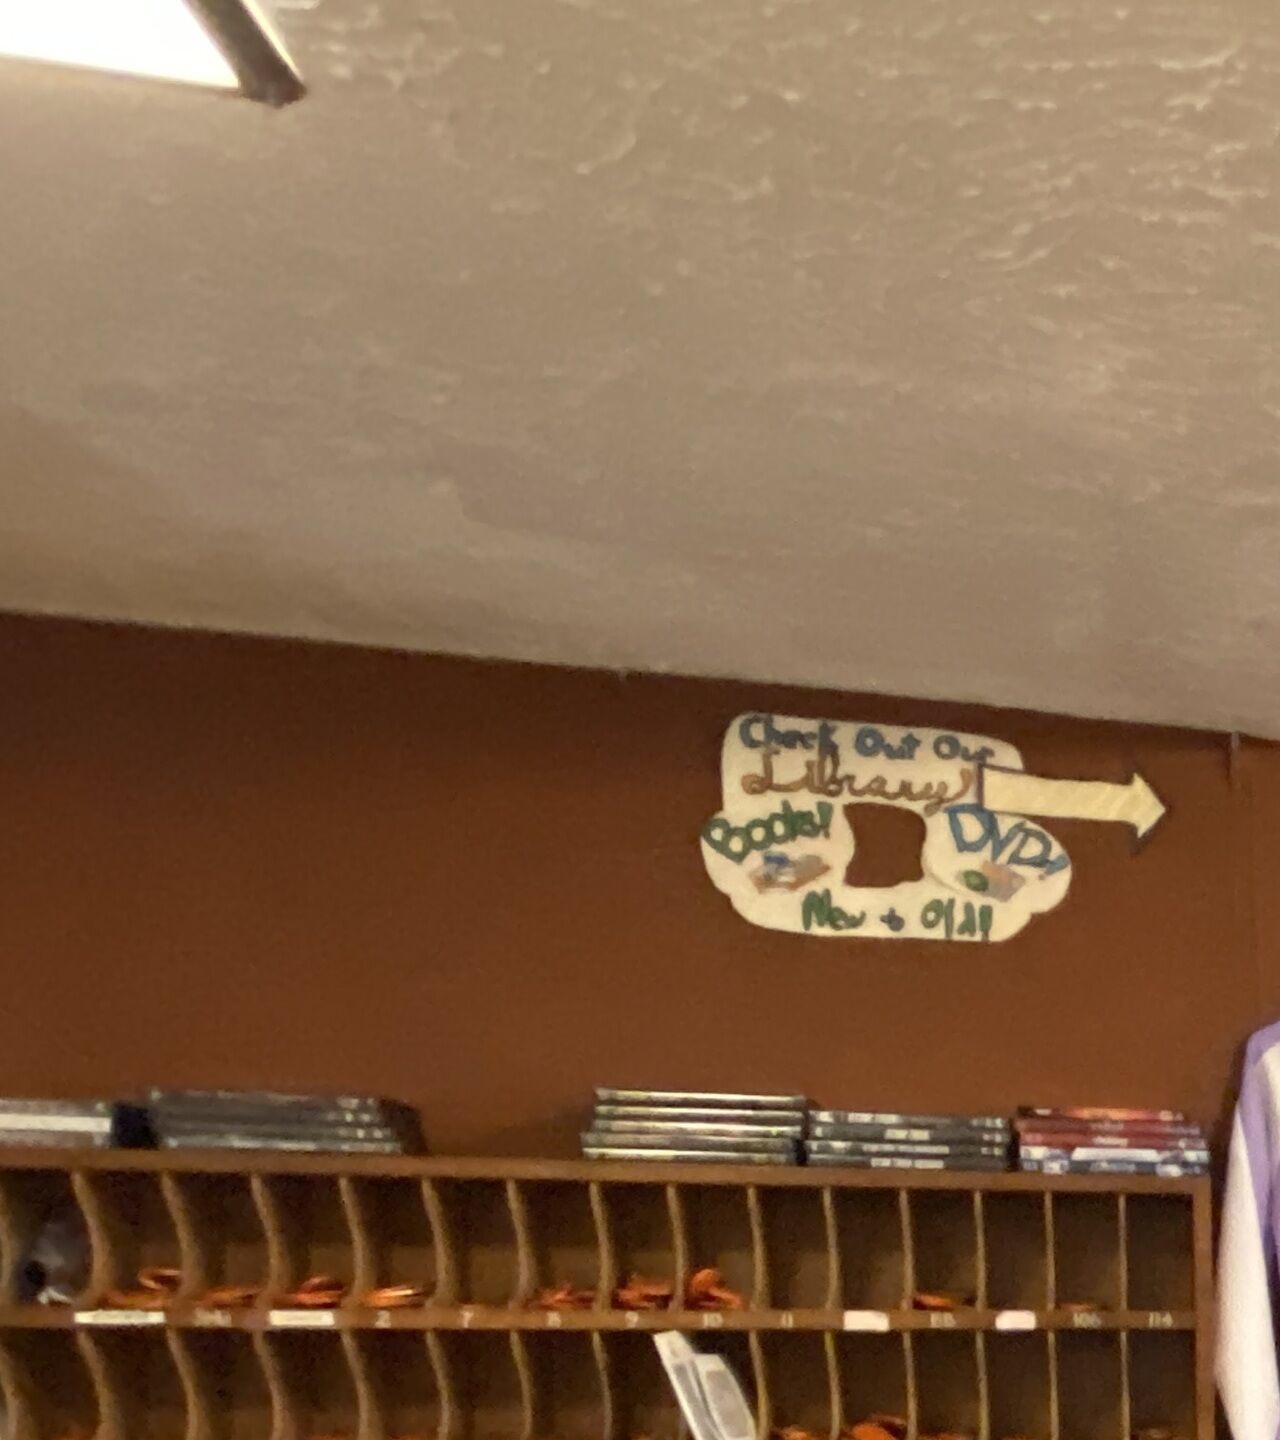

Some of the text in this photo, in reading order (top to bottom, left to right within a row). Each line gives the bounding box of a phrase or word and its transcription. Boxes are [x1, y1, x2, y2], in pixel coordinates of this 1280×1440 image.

[739, 714, 993, 763] Check Out Our
[741, 749, 974, 818] Library
[701, 800, 834, 864] Books!
[802, 888, 866, 931] New
